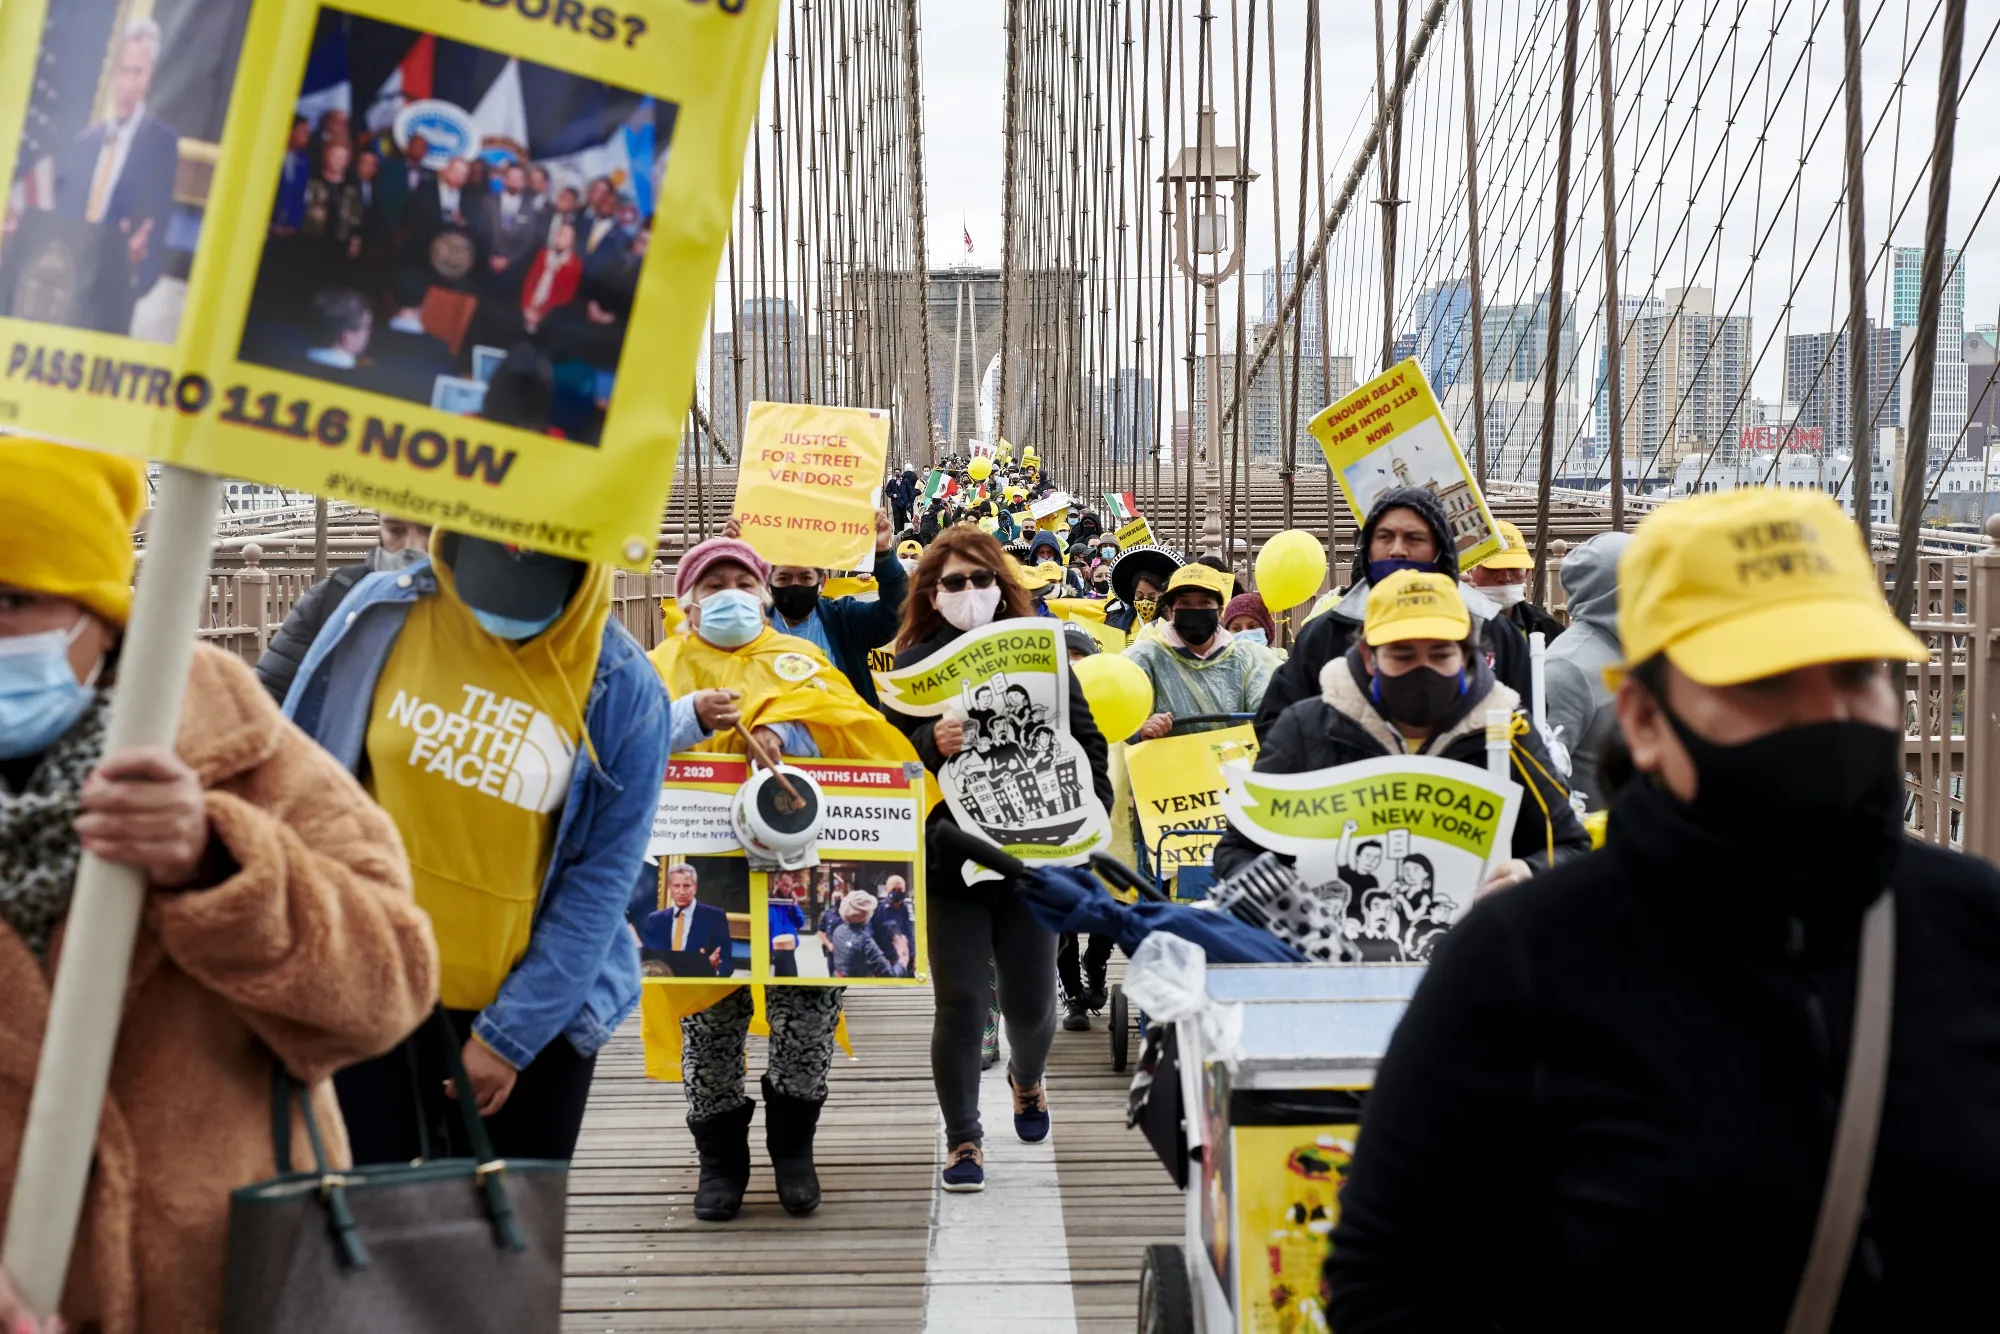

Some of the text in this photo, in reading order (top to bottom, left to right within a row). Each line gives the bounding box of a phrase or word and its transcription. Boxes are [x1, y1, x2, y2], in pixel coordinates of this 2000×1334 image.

[480, 0, 647, 48] ORS?
[1327, 372, 1405, 428] ENOUGH DELAY
[5, 343, 518, 488] PASS INTRO 1116 NOW
[1332, 423, 1359, 445] PASS
[1359, 403, 1391, 429] INTRO
[780, 432, 849, 448] JUSTICE
[1365, 421, 1394, 445] NOW!
[1741, 426, 1825, 449] WELCOME
[761, 449, 863, 468] FOR STREET
[769, 469, 854, 487] VENDORS
[740, 512, 870, 536] PASS INTRO 1116
[911, 636, 1051, 695] MAKE THE ROAD
[976, 653, 1051, 677] NEW YORK
[462, 683, 533, 736] THE
[386, 689, 521, 766] NORTH
[408, 735, 506, 798] FACE
[683, 766, 714, 779] 2020
[806, 769, 892, 785] ONTHS LATER
[1270, 782, 1495, 821] MAKE THE ROAD
[670, 817, 700, 827] longer
[703, 817, 714, 825] be
[1372, 807, 1488, 845] NEW YORK
[650, 831, 677, 840] bility
